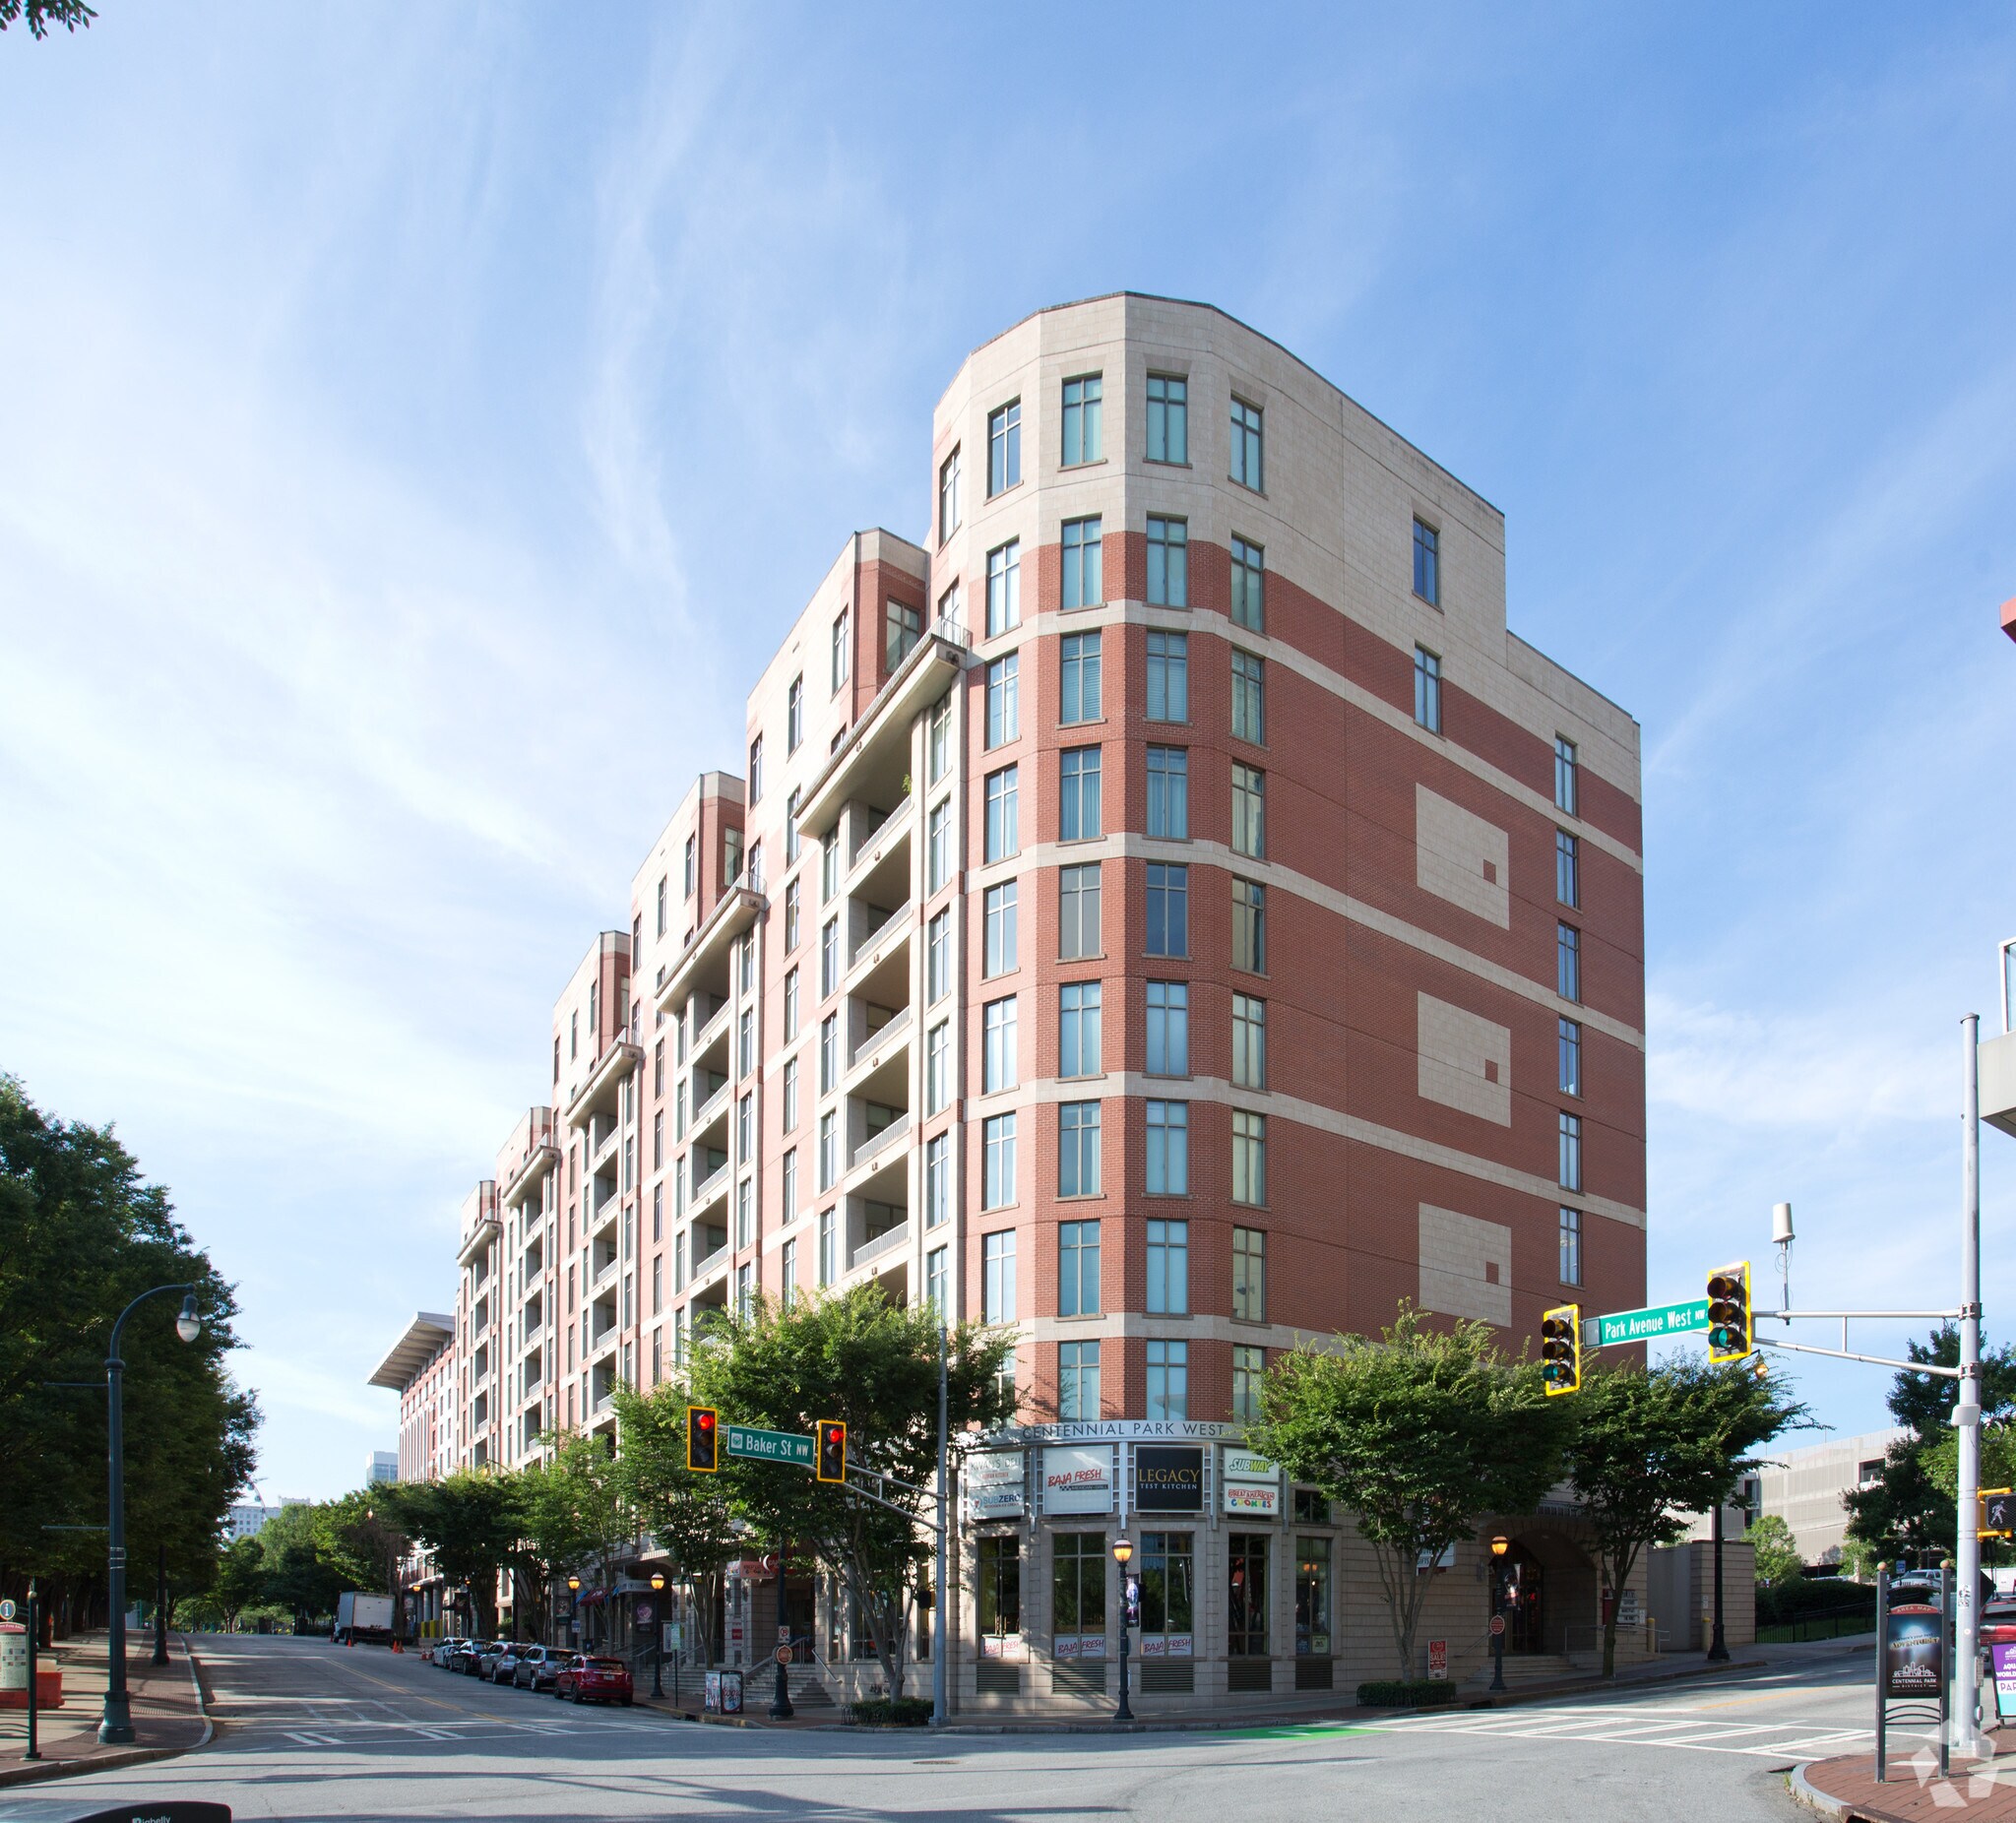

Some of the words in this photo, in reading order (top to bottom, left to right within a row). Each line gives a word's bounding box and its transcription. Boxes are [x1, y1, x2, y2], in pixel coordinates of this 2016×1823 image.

[1606, 1321, 1626, 1339] Park
[1629, 1317, 1664, 1336] Avenue
[1667, 1308, 1691, 1329] West
[1694, 1309, 1706, 1320] NW
[1022, 1422, 1125, 1439] CENTENNIAL
[1133, 1422, 1174, 1435] PARK
[1183, 1422, 1225, 1436] WEST
[746, 1434, 778, 1454] Baker
[780, 1439, 792, 1457] St
[795, 1443, 809, 1457] NW
[1229, 1458, 1275, 1473] SUBWAY
[1047, 1472, 1072, 1487] BAJA
[1074, 1468, 1102, 1481] FRESH
[1138, 1469, 1200, 1482] LEGACY
[1230, 1498, 1272, 1509] COOKIES
[1057, 1642, 1078, 1654] BAJA
[1080, 1639, 1104, 1649] FRESH
[1144, 1641, 1164, 1653] BAJA
[1168, 1638, 1191, 1648] FRESH
